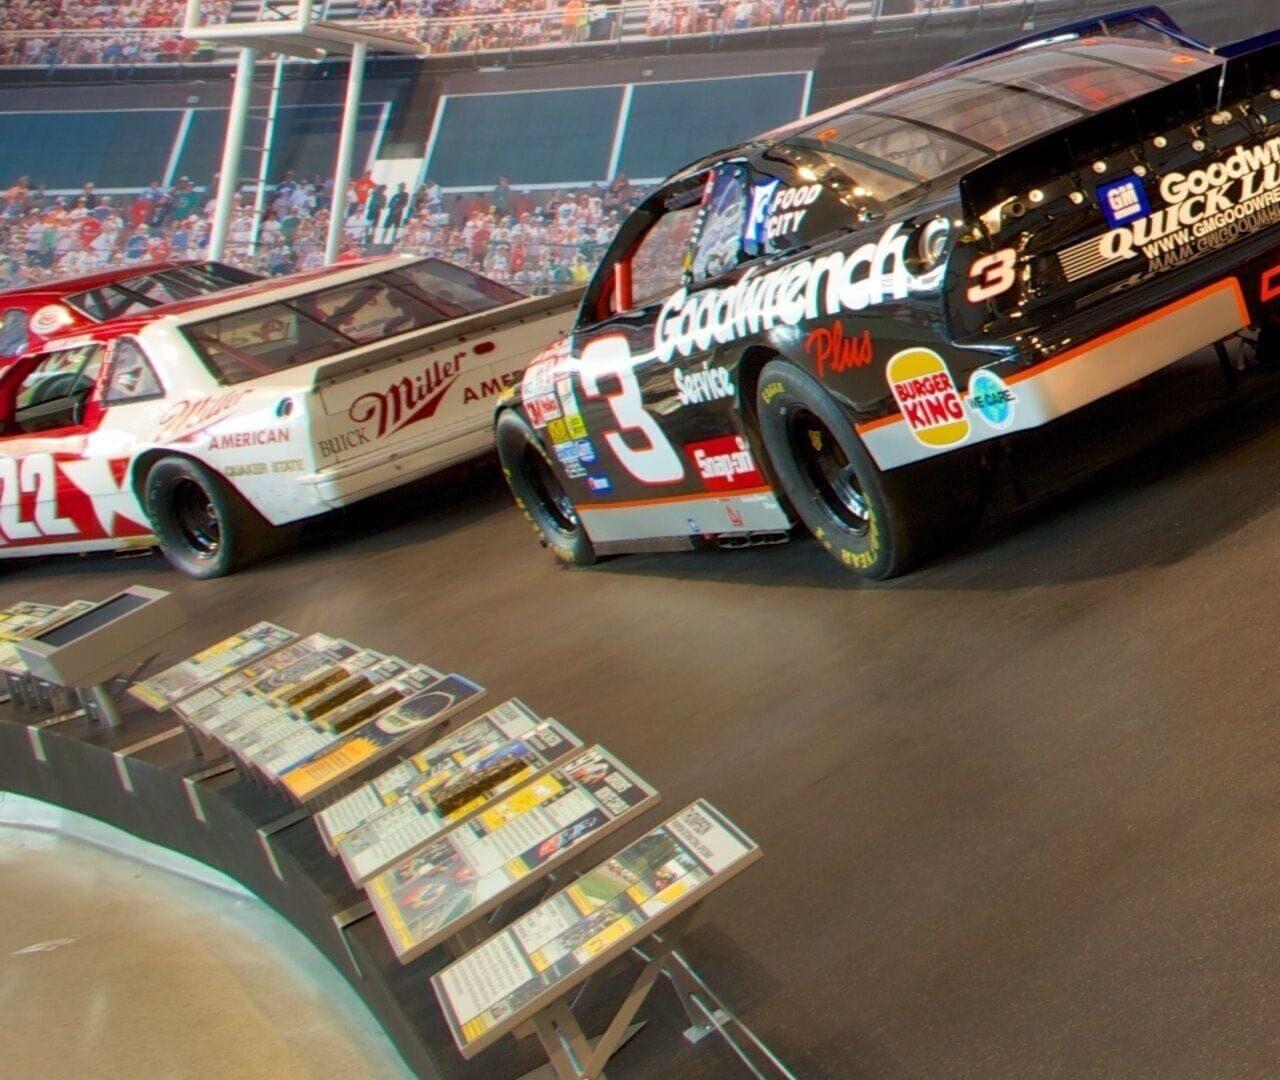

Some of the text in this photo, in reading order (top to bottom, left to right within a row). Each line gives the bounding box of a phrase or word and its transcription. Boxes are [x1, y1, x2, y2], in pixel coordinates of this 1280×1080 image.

[770, 183, 823, 215] FOOD
[1106, 182, 1139, 212] GM
[766, 209, 808, 239] CITY
[1099, 180, 1238, 260] QUICK
[654, 221, 911, 364] Goodwrench
[966, 247, 1017, 305] 3
[805, 320, 874, 377] Plus
[349, 351, 467, 439] Miller
[674, 360, 736, 406] Service
[895, 371, 953, 404] BURGER
[155, 388, 255, 443] Miller
[579, 332, 686, 486] 3
[903, 392, 965, 430] KING
[208, 428, 290, 452] AMERICAN
[317, 427, 371, 458] BUICK
[224, 461, 268, 478] QUAKER
